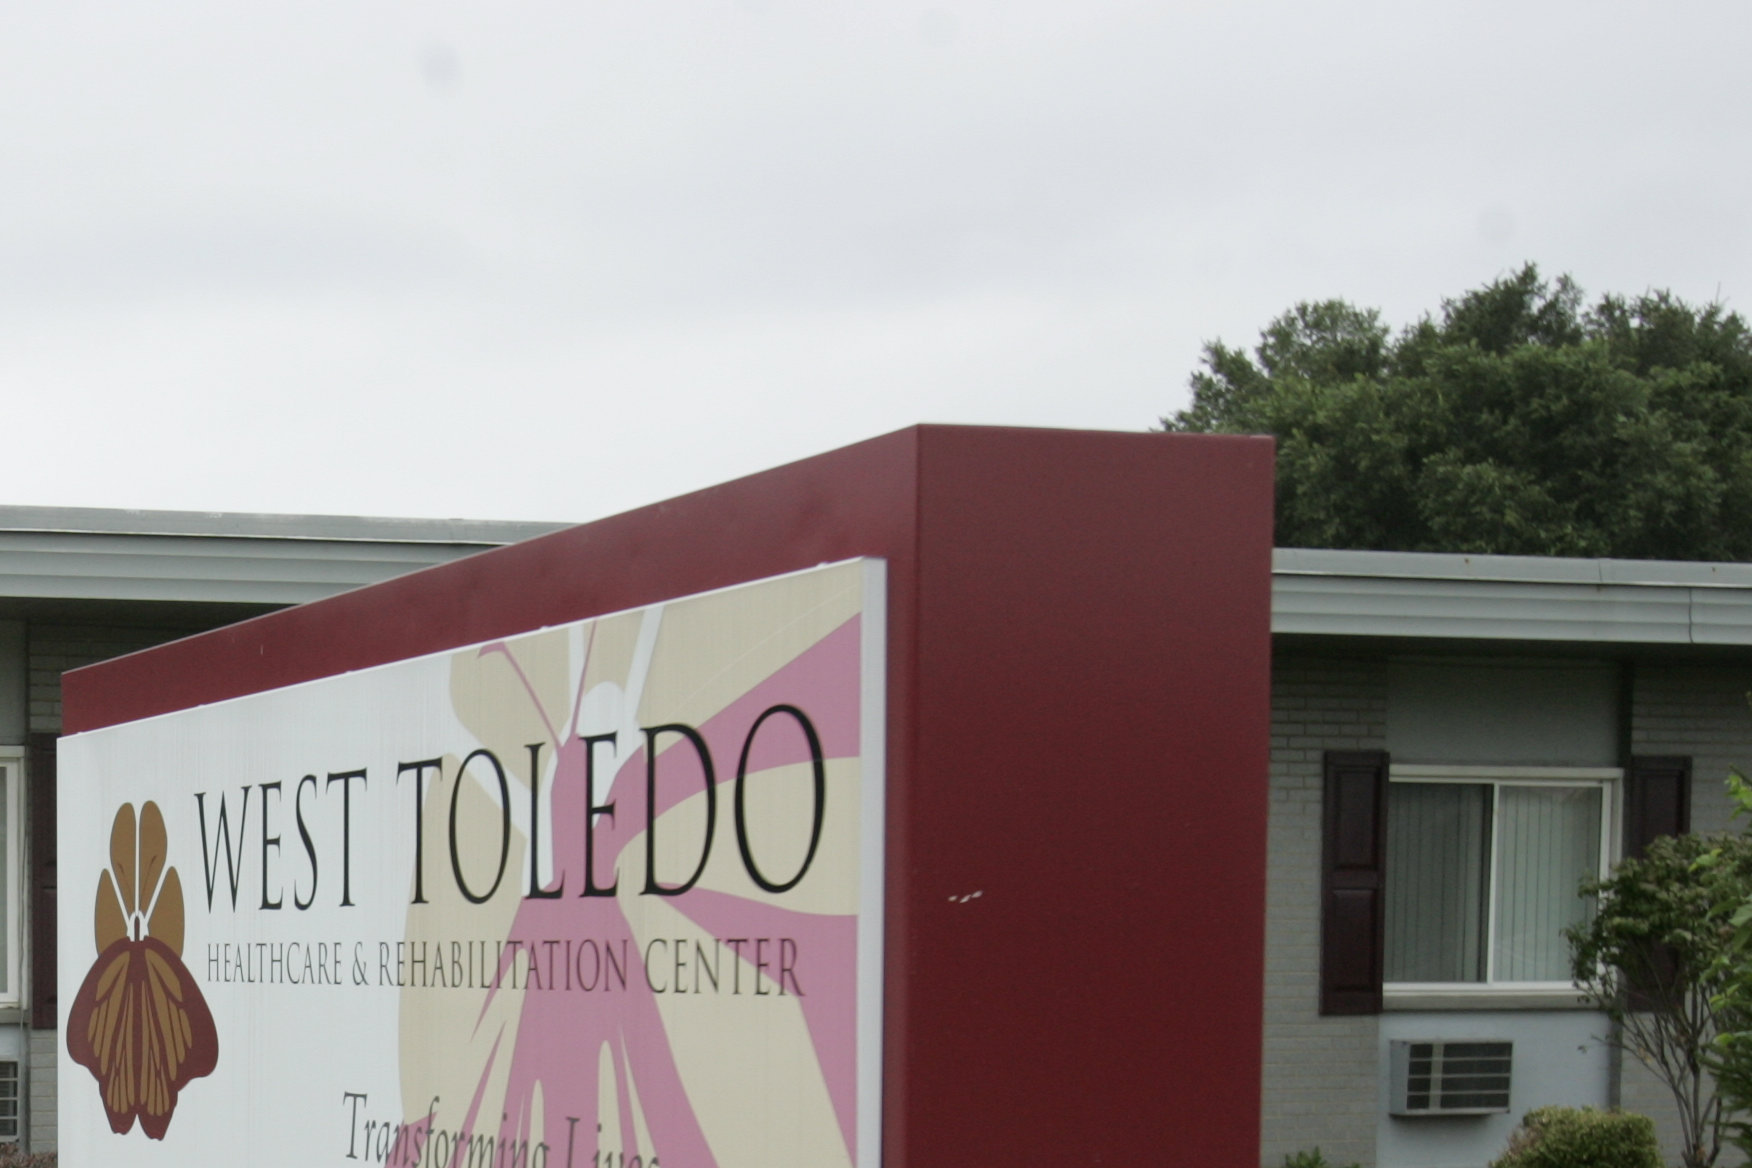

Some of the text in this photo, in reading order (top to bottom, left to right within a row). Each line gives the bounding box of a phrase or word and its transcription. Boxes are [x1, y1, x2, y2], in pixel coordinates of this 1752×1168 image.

[194, 704, 825, 914] WEST TOLEDO
[207, 938, 806, 997] HEALTHCARE & REHABILITATION CENTER
